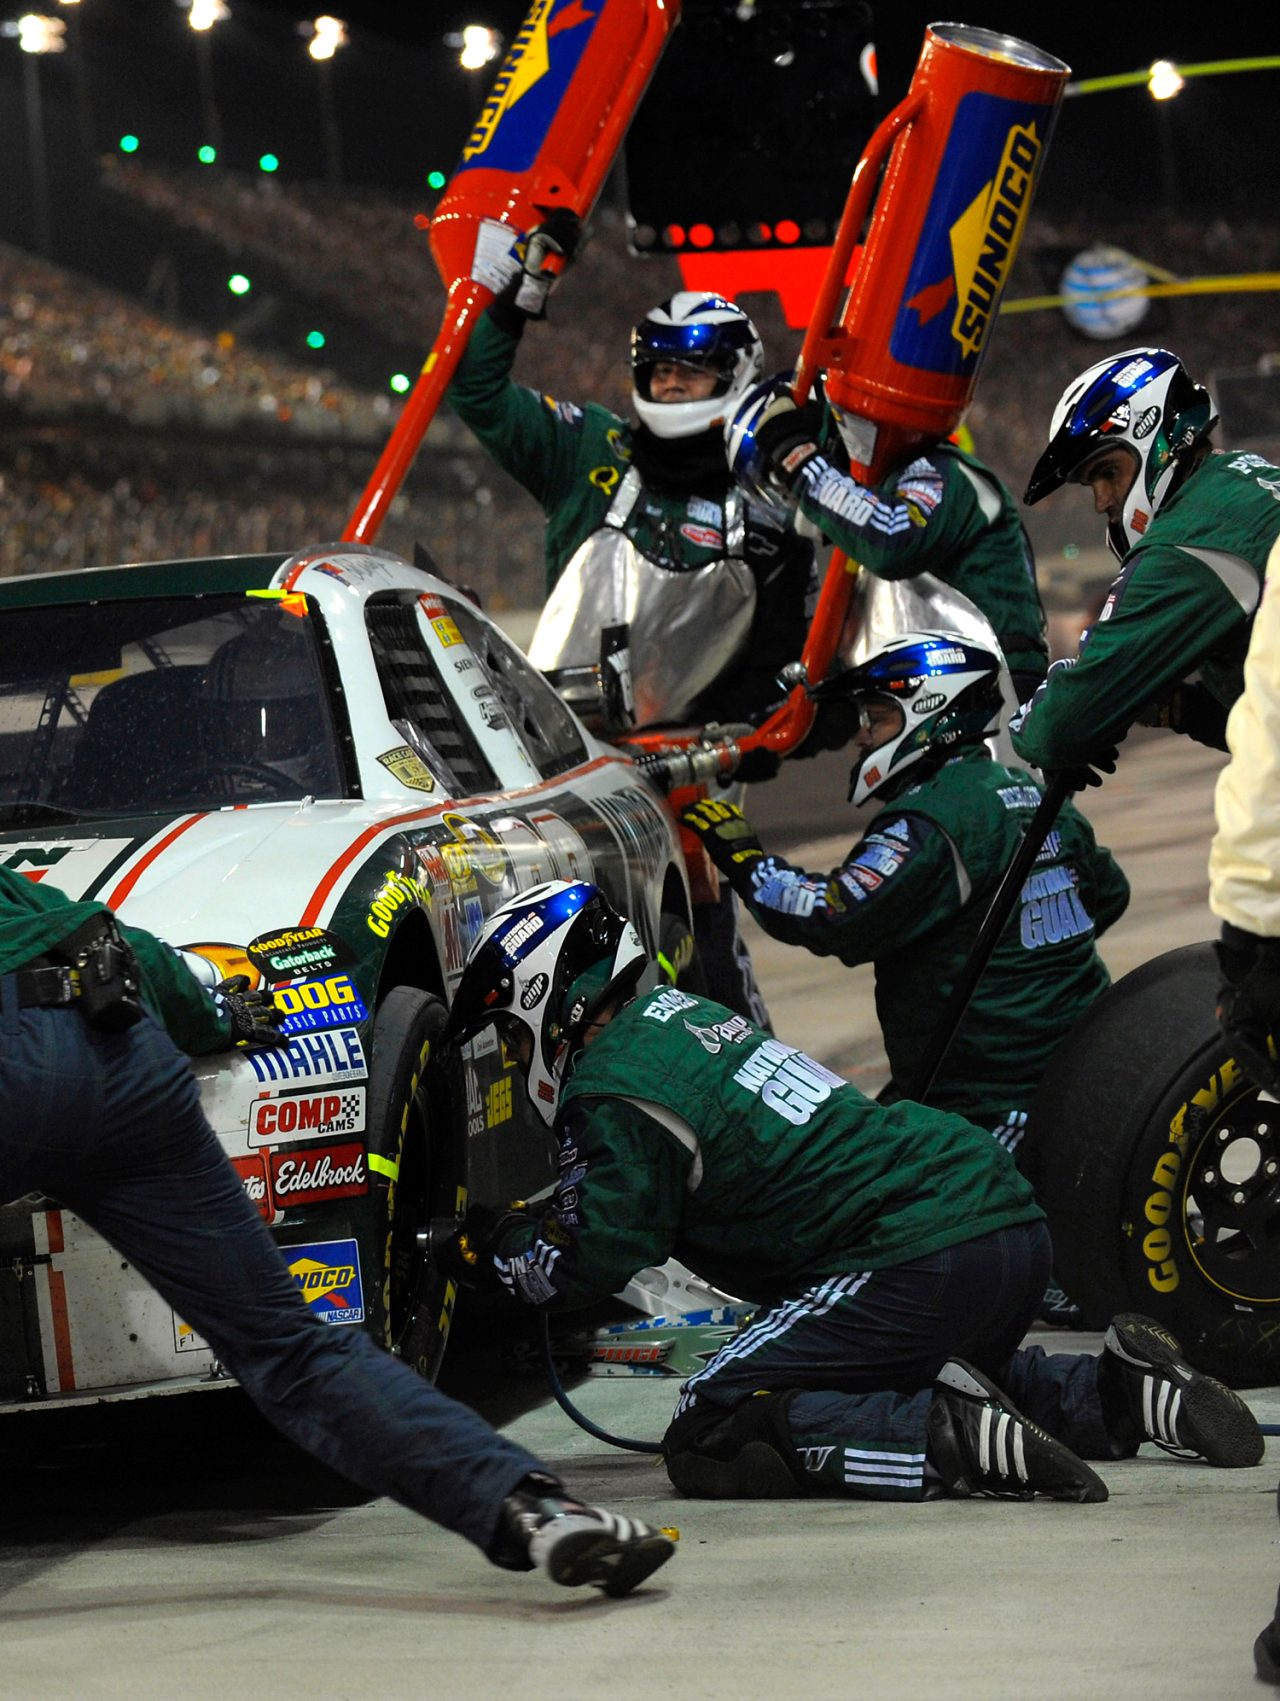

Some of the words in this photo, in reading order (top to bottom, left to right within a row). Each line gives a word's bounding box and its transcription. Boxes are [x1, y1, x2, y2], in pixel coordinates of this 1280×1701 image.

[957, 130, 1039, 347] SUNOCO
[249, 927, 325, 953] GOODYEAR
[504, 916, 544, 956] GUARD
[270, 944, 336, 971] Gatorback
[293, 960, 333, 975] BELTS
[273, 975, 356, 1015] OOG
[278, 1012, 317, 1034] ASSIS
[323, 1005, 362, 1024] PARTS
[243, 1030, 364, 1083] MAHLE
[256, 1095, 341, 1136] COMP
[318, 1118, 355, 1134] CAMS
[275, 1153, 366, 1195] Edelbrock
[291, 1269, 352, 1290] NOCO
[326, 1309, 360, 1322] NASCAR
